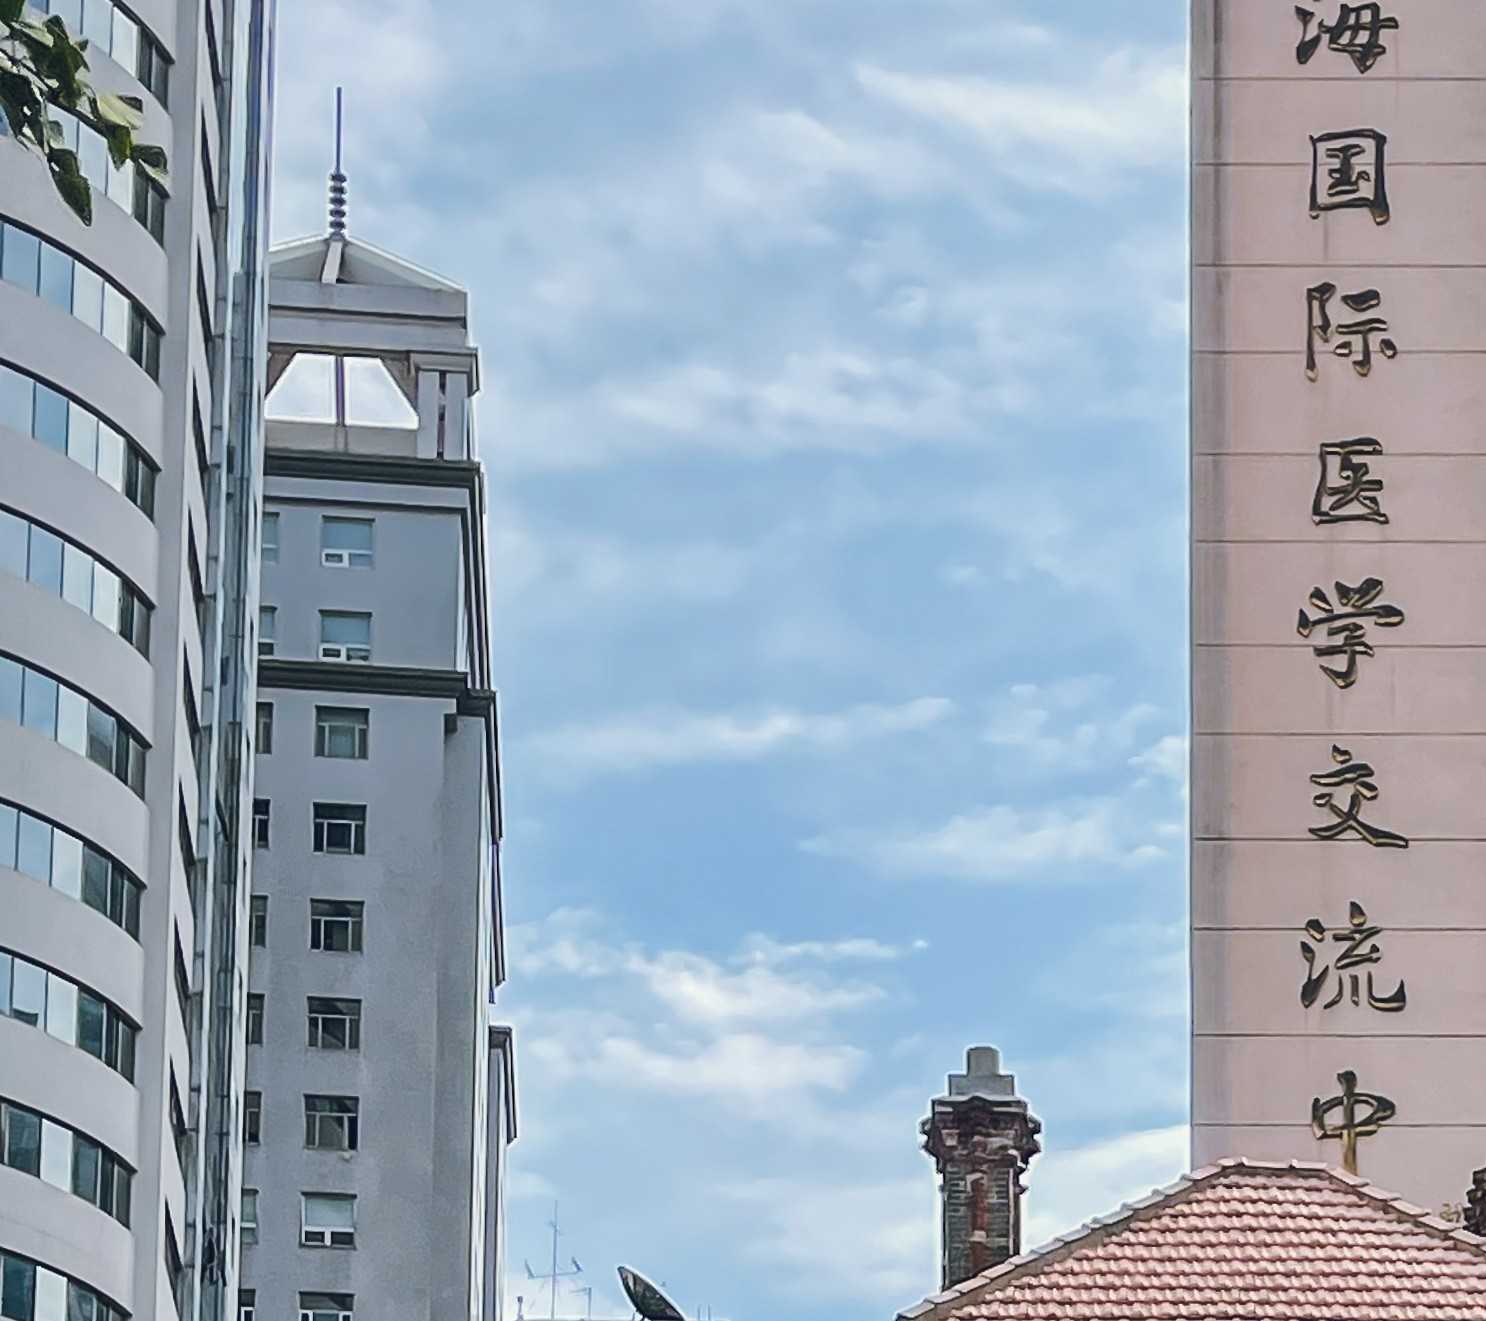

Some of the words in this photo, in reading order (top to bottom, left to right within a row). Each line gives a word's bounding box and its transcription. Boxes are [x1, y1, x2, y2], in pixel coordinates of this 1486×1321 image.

[1294, 0, 1408, 1175] 海国际医学交流中
